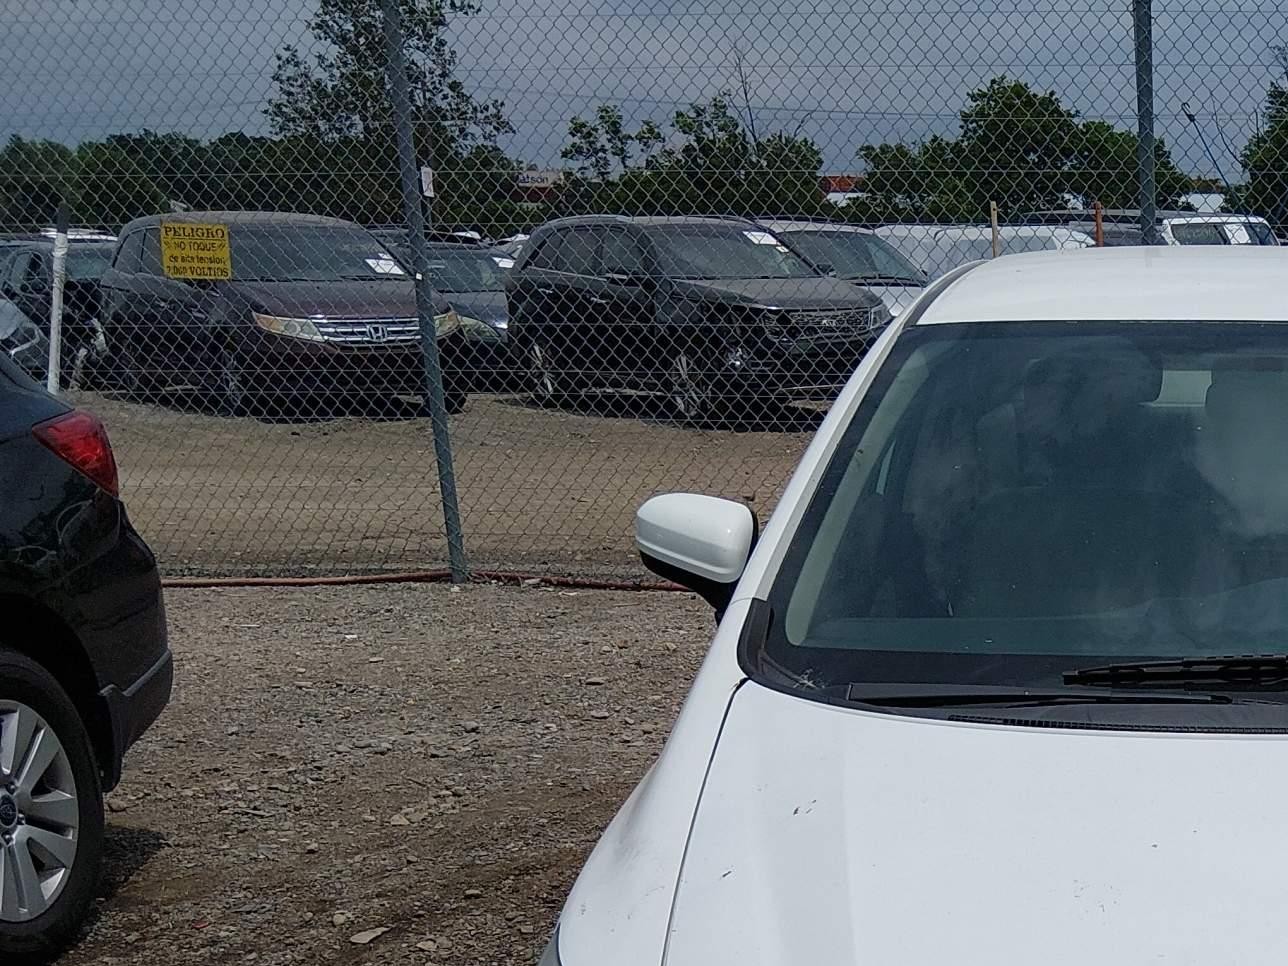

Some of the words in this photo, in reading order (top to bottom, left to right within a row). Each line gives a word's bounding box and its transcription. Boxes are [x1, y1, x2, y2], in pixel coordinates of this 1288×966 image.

[164, 226, 225, 238] PELIGRO
[174, 241, 186, 251] NO
[189, 241, 217, 252] TOQUE
[189, 266, 229, 277] VOLTIOS
